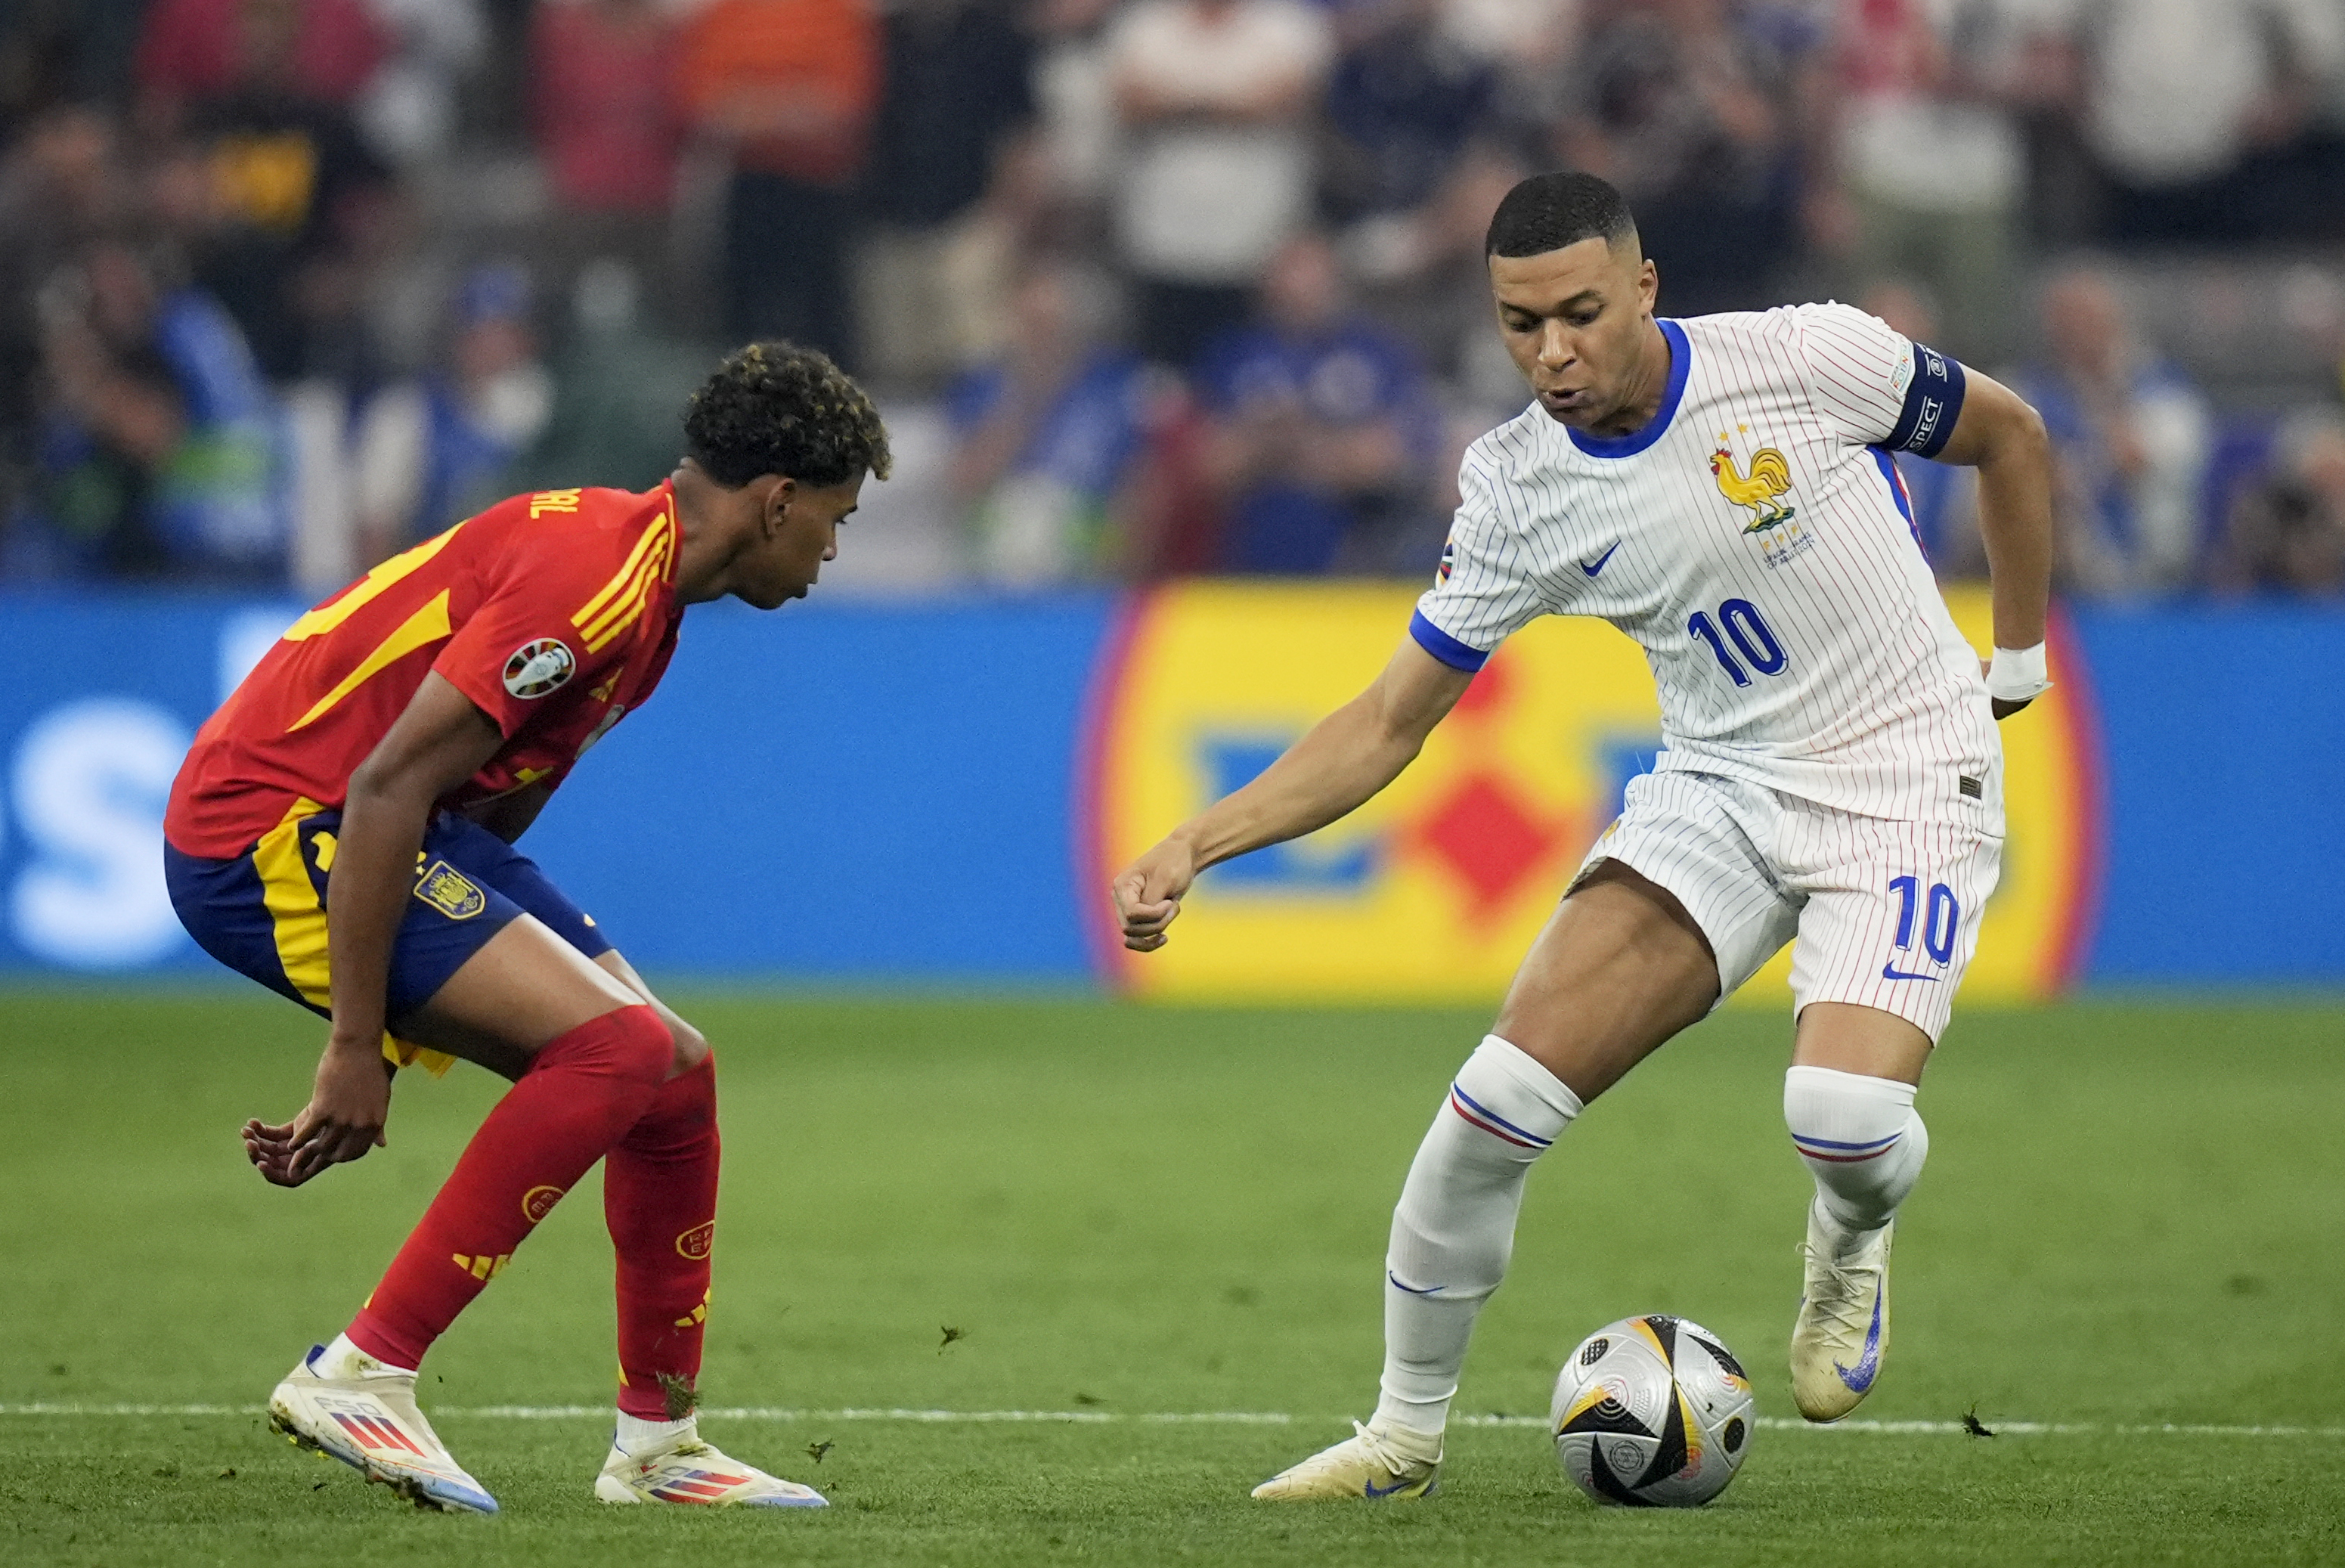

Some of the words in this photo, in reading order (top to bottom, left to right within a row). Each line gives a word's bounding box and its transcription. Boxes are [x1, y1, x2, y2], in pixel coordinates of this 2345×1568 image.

[1910, 398, 1939, 449] SPECT
[1687, 598, 1789, 688] 10
[1889, 875, 1960, 969] 10
